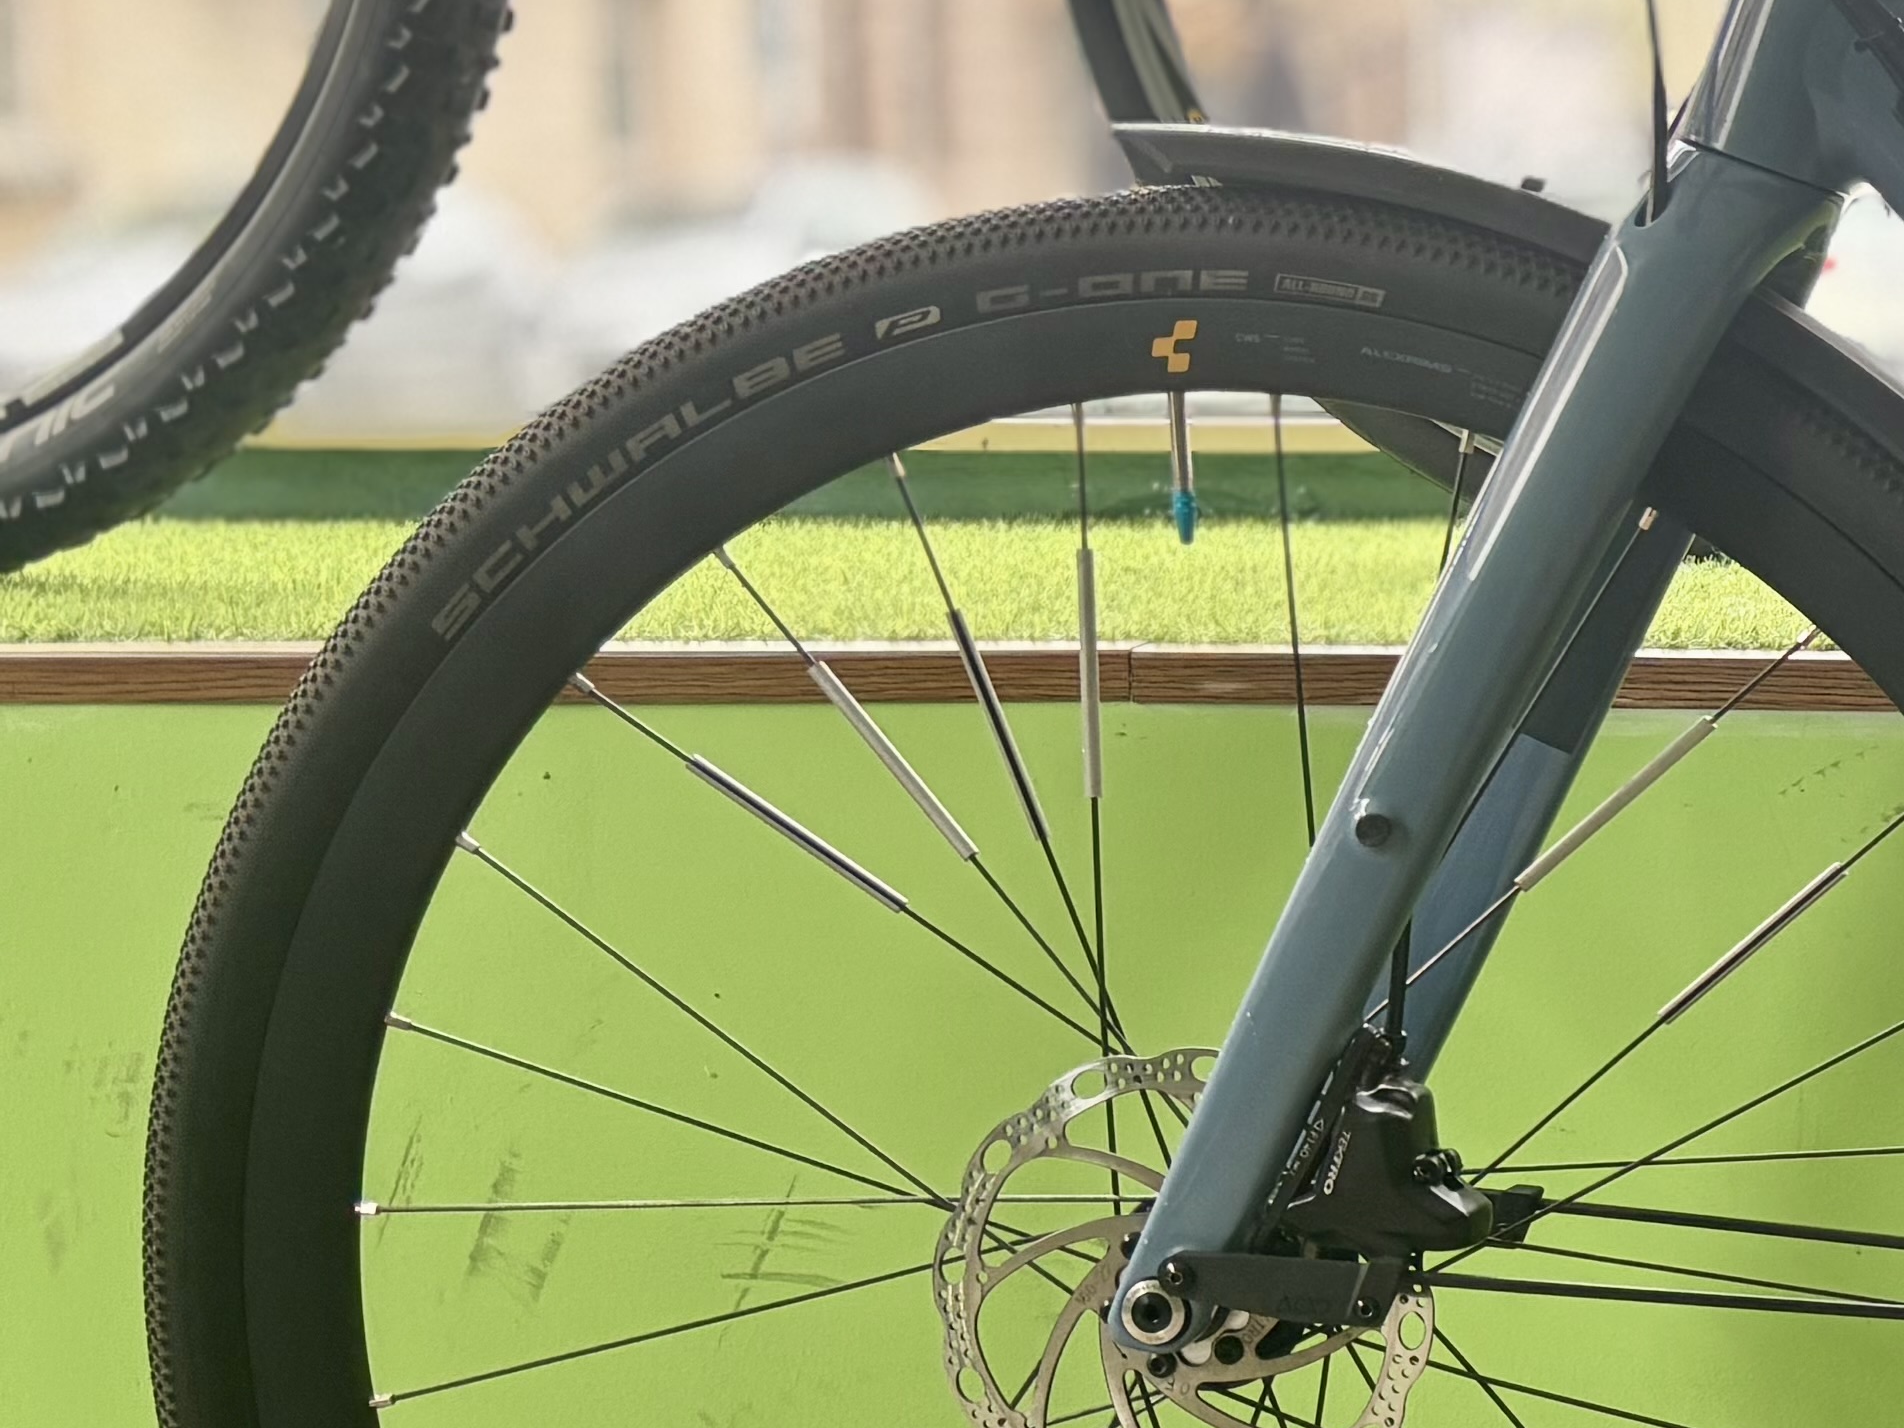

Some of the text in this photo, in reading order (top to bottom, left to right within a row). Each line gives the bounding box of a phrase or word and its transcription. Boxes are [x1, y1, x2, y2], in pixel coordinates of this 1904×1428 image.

[976, 270, 1249, 314] G-ONE
[431, 333, 847, 641] SCHWALBE
[1323, 1130, 1352, 1196] TEKTRO
